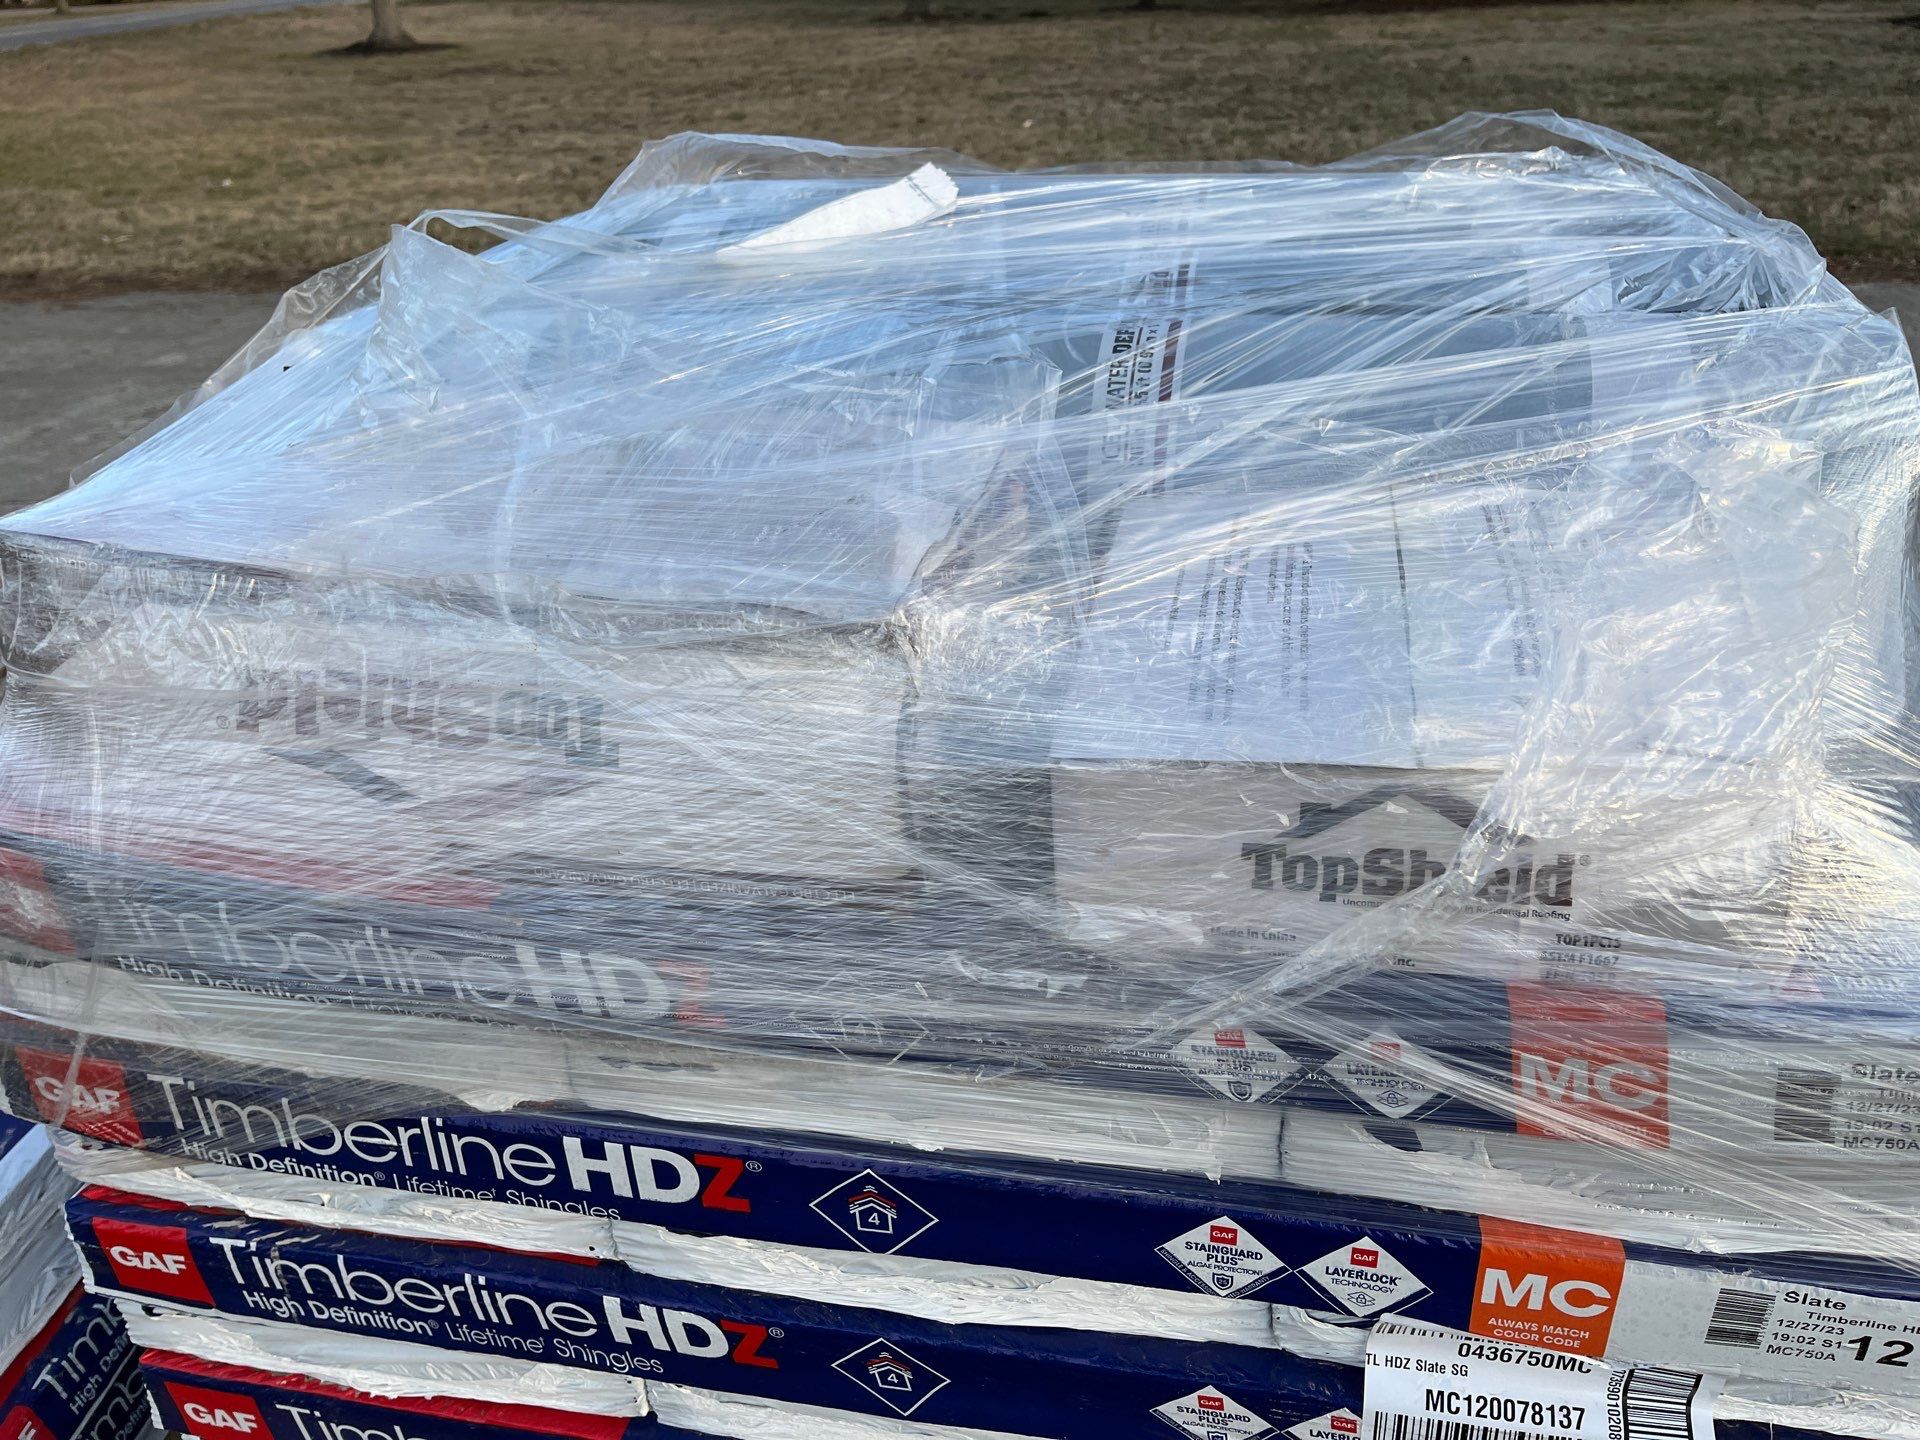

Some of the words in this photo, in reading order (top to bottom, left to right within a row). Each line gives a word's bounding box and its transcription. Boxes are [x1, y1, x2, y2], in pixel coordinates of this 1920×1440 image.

[1240, 843, 1592, 908] TopSheld®
[1519, 1052, 1662, 1110] MC
[1212, 1230, 1236, 1240] GAF
[109, 1245, 188, 1276] GAF
[1184, 1240, 1264, 1262] STAINGUARD
[1353, 1252, 1376, 1263] GAF
[1330, 1277, 1395, 1295] TECHNOLOGY
[1480, 1267, 1612, 1318] MC
[1783, 1290, 1847, 1311] Slate
[242, 1289, 305, 1318] High
[553, 1337, 664, 1374] Shingles
[1487, 1317, 1539, 1331] ALWAYS
[1542, 1323, 1590, 1339] MATCH
[1776, 1318, 1845, 1336] 12/27/23
[1806, 1311, 1897, 1332] Timberline
[1493, 1328, 1540, 1342] COLOR
[1543, 1334, 1582, 1348] CODE
[1771, 1331, 1816, 1346] 19:02
[1765, 1343, 1836, 1362] MC750A
[1385, 1354, 1411, 1370] HDZ
[1415, 1359, 1447, 1375] Slate
[1450, 1363, 1469, 1378] SG
[183, 1402, 258, 1433] GAF
[1175, 1404, 1252, 1424] STAINGUARD
[1424, 1388, 1586, 1431] MC120078137
